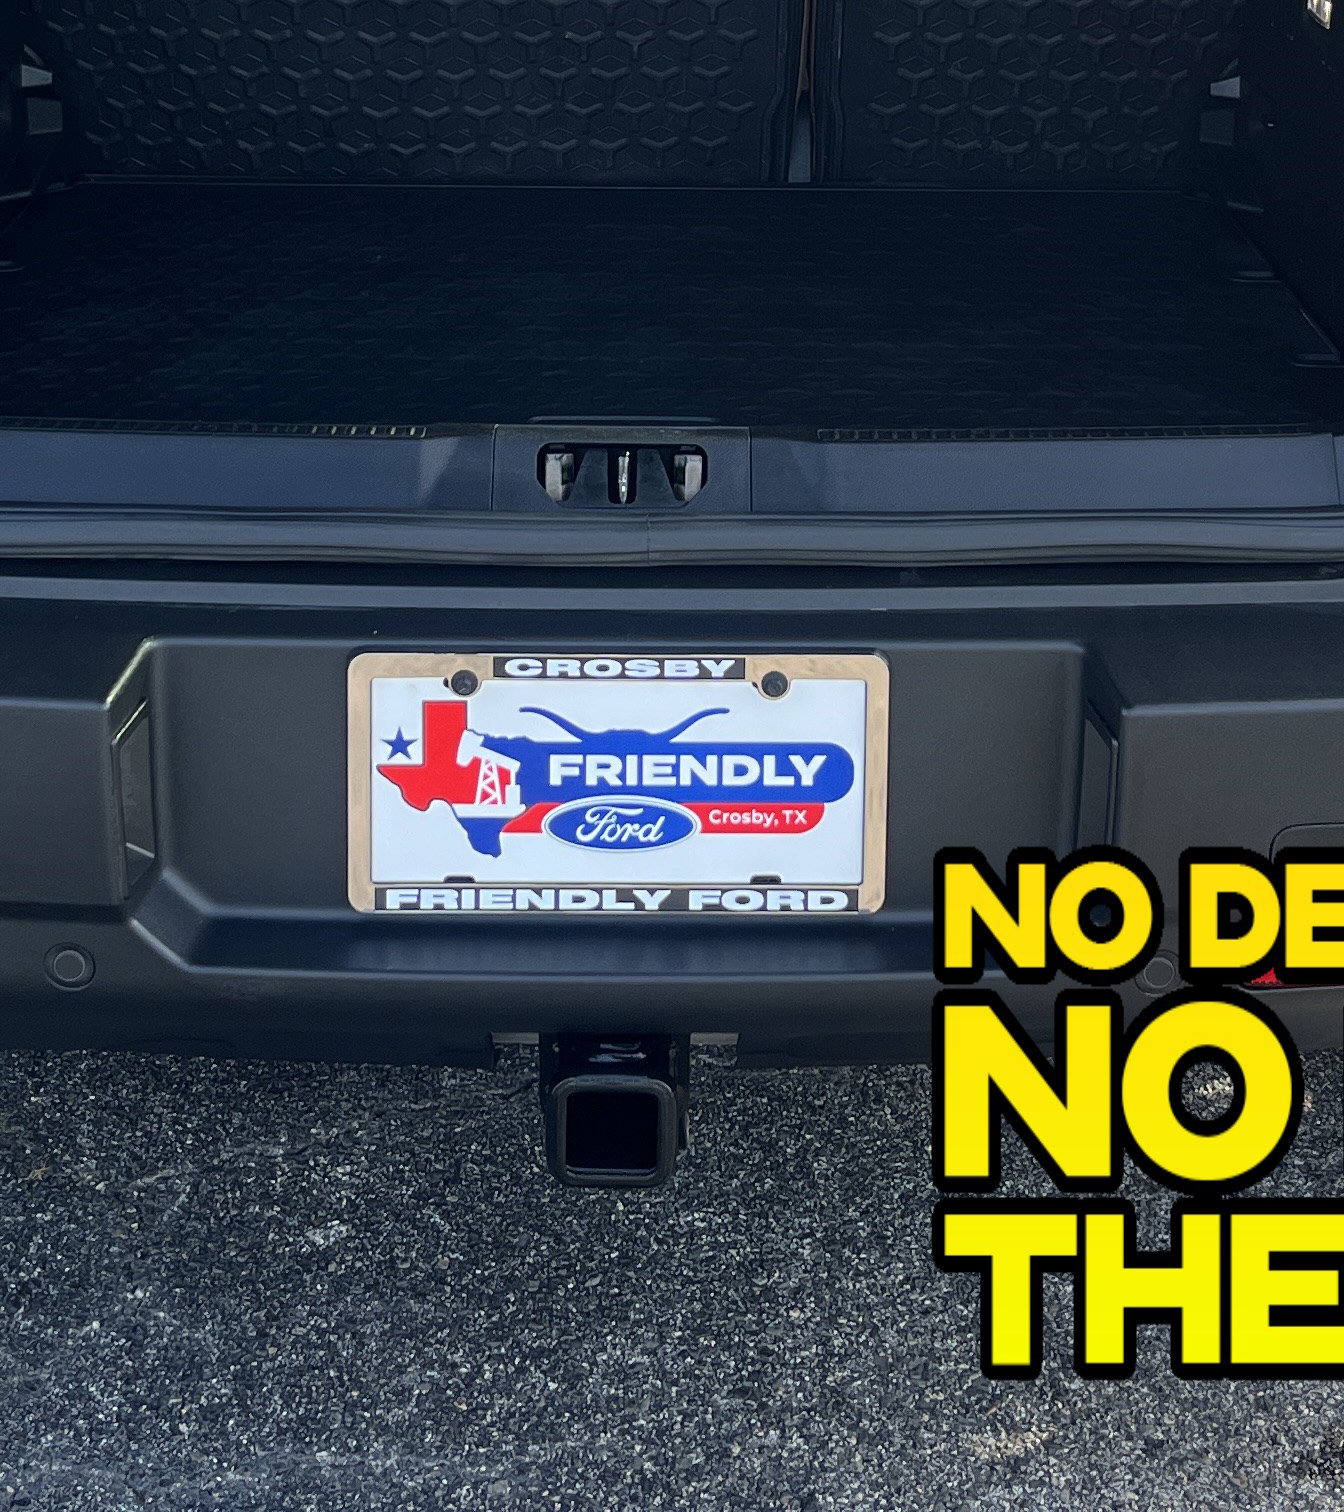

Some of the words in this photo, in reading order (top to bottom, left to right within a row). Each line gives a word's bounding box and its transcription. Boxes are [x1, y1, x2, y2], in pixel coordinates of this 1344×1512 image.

[504, 658, 736, 678] CROSBY
[548, 754, 828, 787] FRIENDLY
[575, 805, 666, 842] Ford
[708, 809, 779, 827] Crosby,
[781, 809, 808, 825] TX
[385, 889, 672, 911] FRIENDLY
[688, 889, 849, 911] FORD
